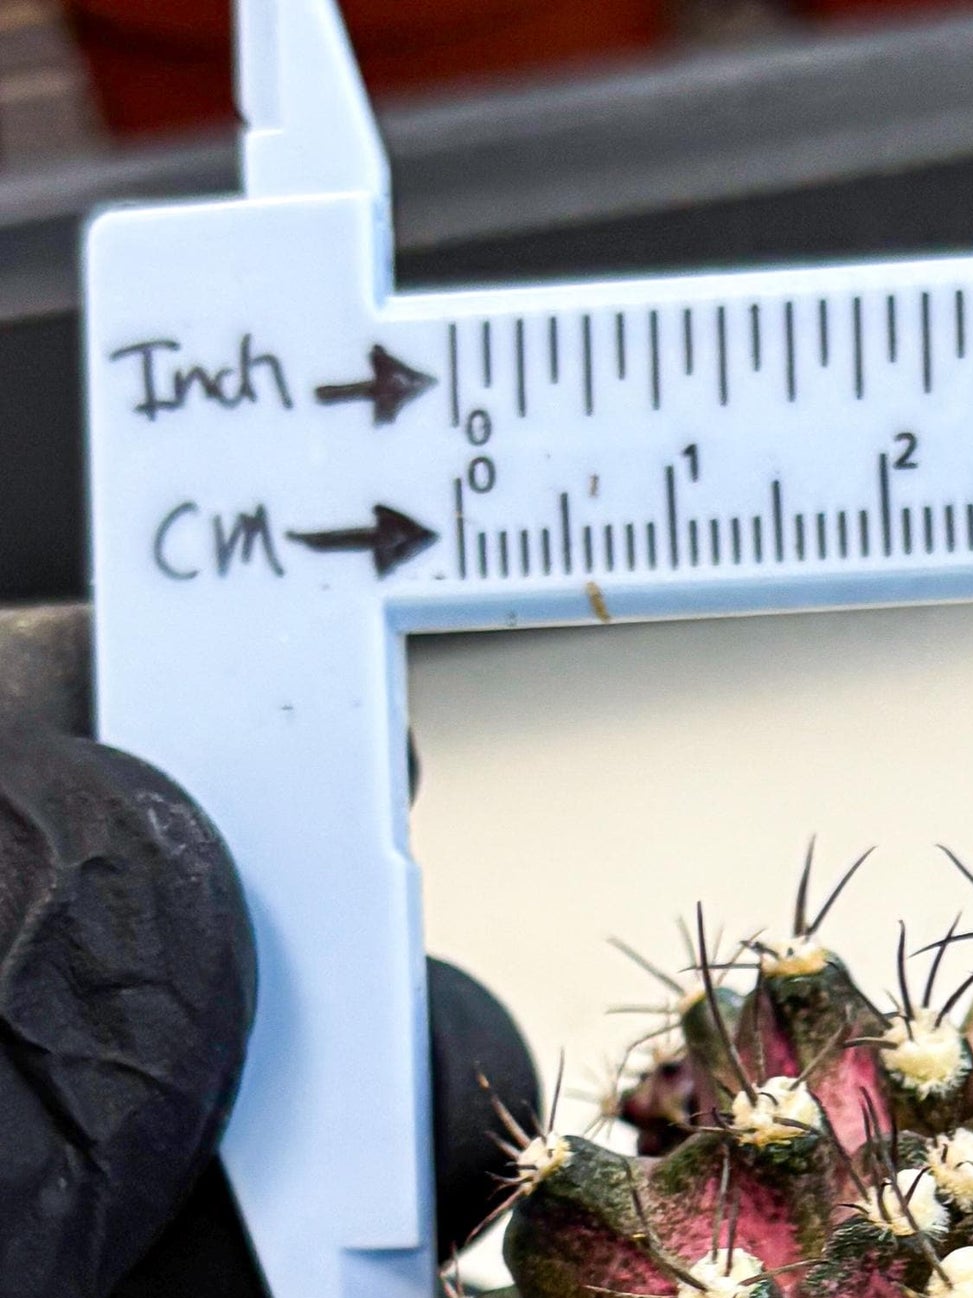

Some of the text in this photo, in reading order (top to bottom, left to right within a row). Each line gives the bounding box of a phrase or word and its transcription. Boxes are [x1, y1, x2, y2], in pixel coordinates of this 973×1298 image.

[109, 332, 293, 422] Inch
[466, 409, 492, 446] 0
[468, 456, 496, 494] 0
[682, 443, 699, 482] 1
[893, 432, 918, 470] 2
